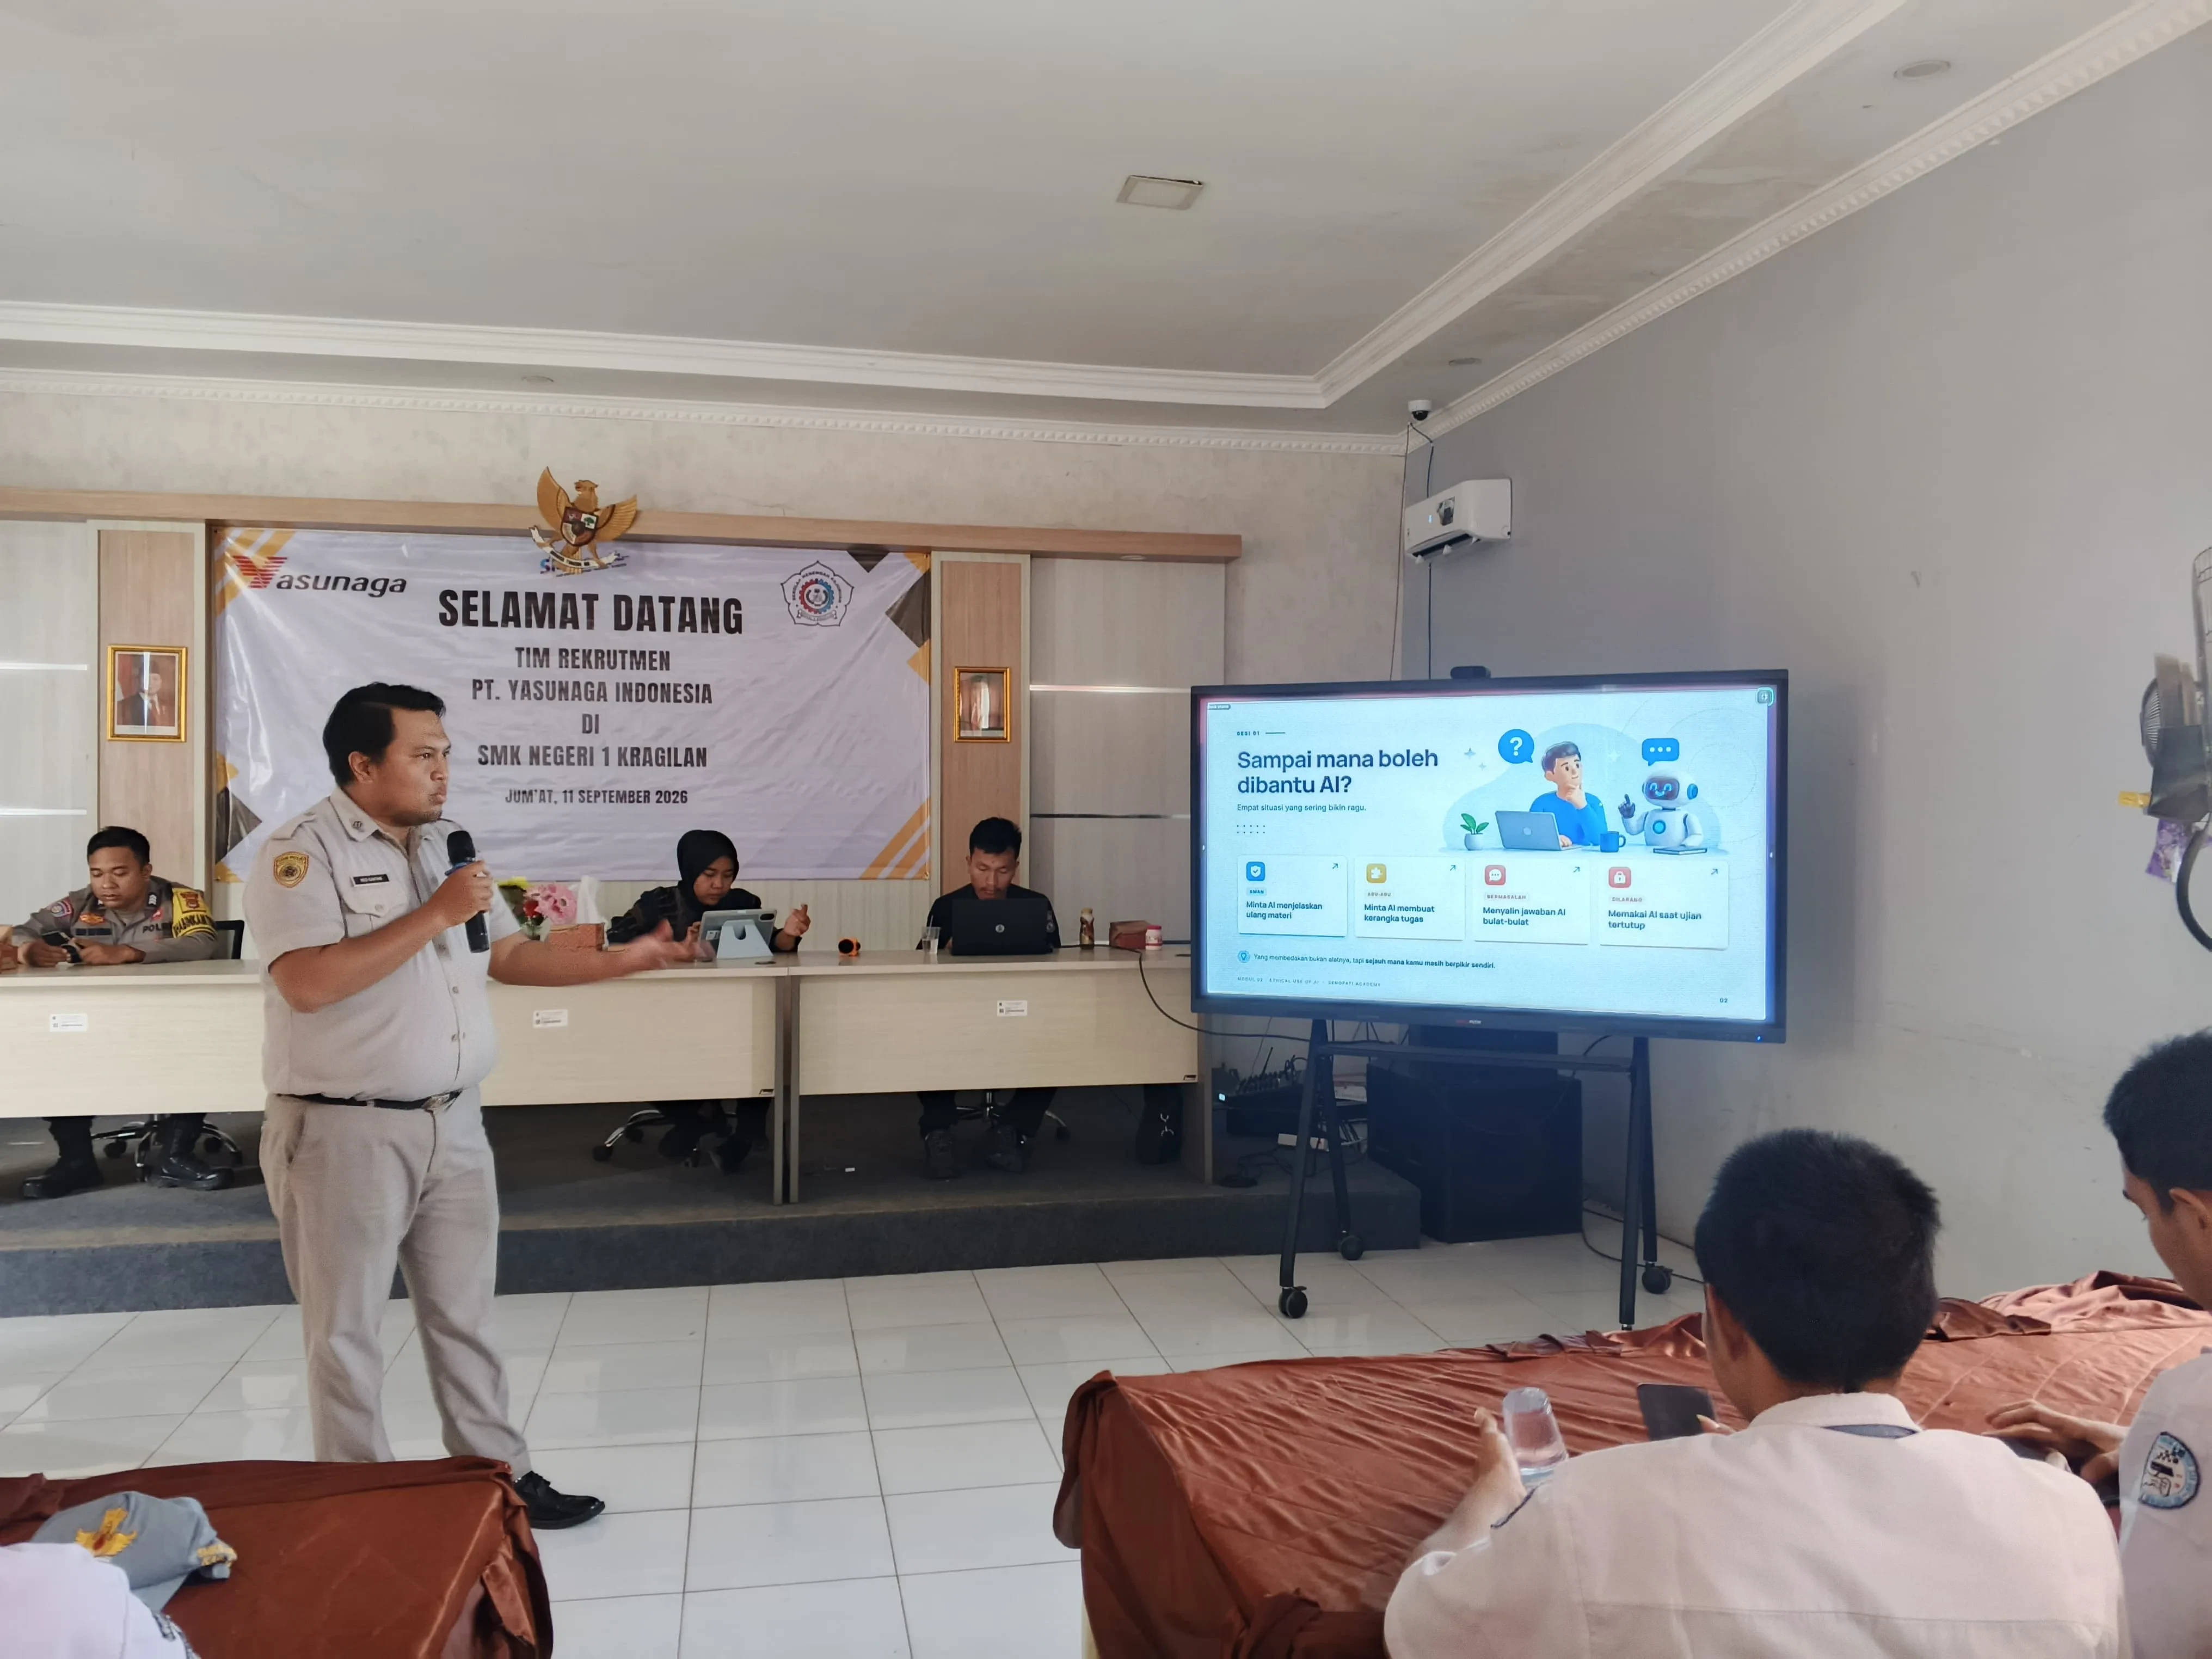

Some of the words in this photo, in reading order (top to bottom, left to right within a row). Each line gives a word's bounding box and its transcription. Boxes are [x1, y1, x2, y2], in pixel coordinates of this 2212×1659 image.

[233, 555, 407, 598] Yasunaga
[439, 589, 598, 630] SELAMAT
[614, 594, 742, 634] DATANG
[515, 647, 549, 668] TIM
[559, 648, 669, 671] REKRUTMEN
[472, 679, 500, 699] PT.
[508, 680, 607, 702] YASUNAGA
[616, 683, 712, 703] INDONESIA
[582, 714, 599, 734] DI
[478, 745, 521, 765] SMK
[530, 746, 593, 766] NEGERI
[602, 747, 609, 766] 1
[618, 747, 706, 767] KRAGILAN
[1238, 751, 1311, 772] Sampai
[1317, 754, 1373, 767] mana
[1379, 749, 1437, 767] boleh
[1238, 777, 1314, 793] dibantu
[1320, 776, 1351, 792] AI?
[506, 789, 557, 804] JUM'AT,
[563, 790, 573, 802] 11
[579, 790, 650, 803] SEPTEMBER
[656, 790, 687, 803] 2026
[1237, 804, 1259, 812] Empat
[1304, 804, 1326, 813] sering
[1276, 902, 1323, 911] menjelaskan
[1483, 907, 1520, 916] Menyalin
[1521, 907, 1556, 917] jawaban
[1246, 911, 1267, 920] ulang
[1364, 914, 1399, 924] kerangka
[1400, 915, 1423, 924] tugas
[1483, 917, 1529, 926] bulat-bulat
[1608, 910, 1647, 918] Memakai
[1680, 911, 1702, 921] ujian
[1608, 920, 1645, 931] tertutup
[1254, 953, 1268, 961] Yang
